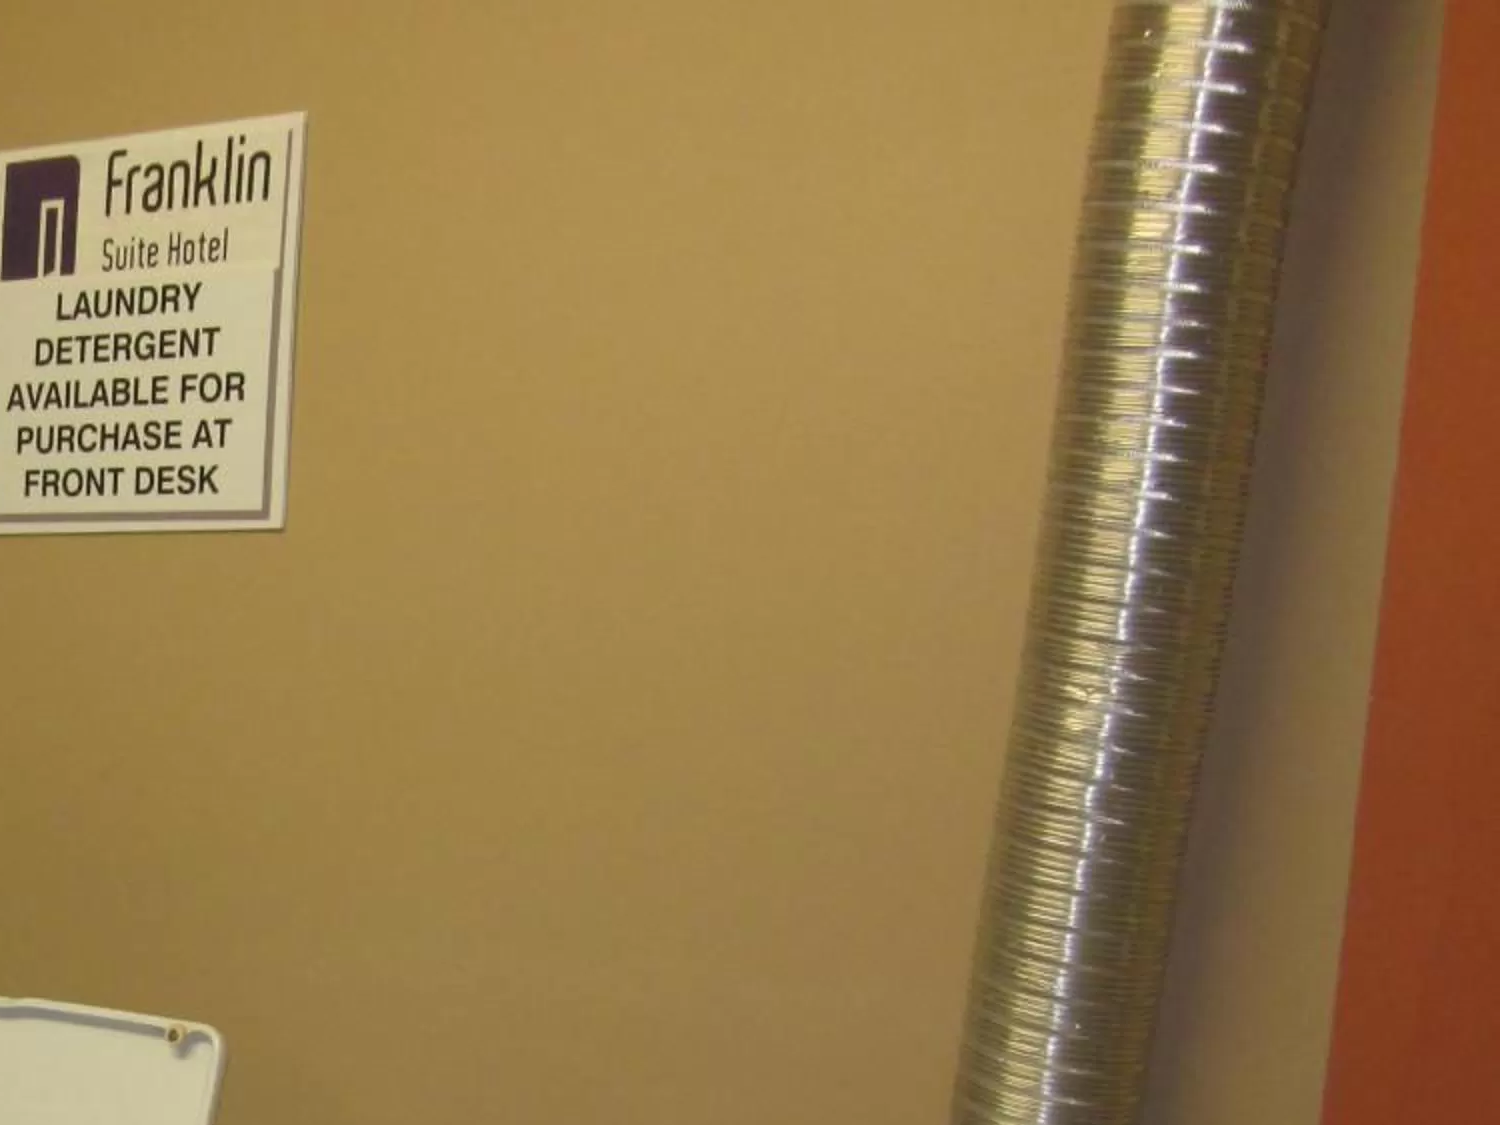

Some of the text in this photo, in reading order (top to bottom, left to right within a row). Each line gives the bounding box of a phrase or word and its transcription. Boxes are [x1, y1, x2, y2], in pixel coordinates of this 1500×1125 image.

[105, 135, 272, 217] Franklin
[102, 227, 229, 273] Suite Hotel
[56, 281, 203, 321] LAUNDRY
[35, 327, 221, 367] DETERGENT
[6, 371, 246, 412] AVAILABLE FOR
[16, 418, 233, 455] PURCHASE AT
[24, 465, 219, 498] FRONT DESK
